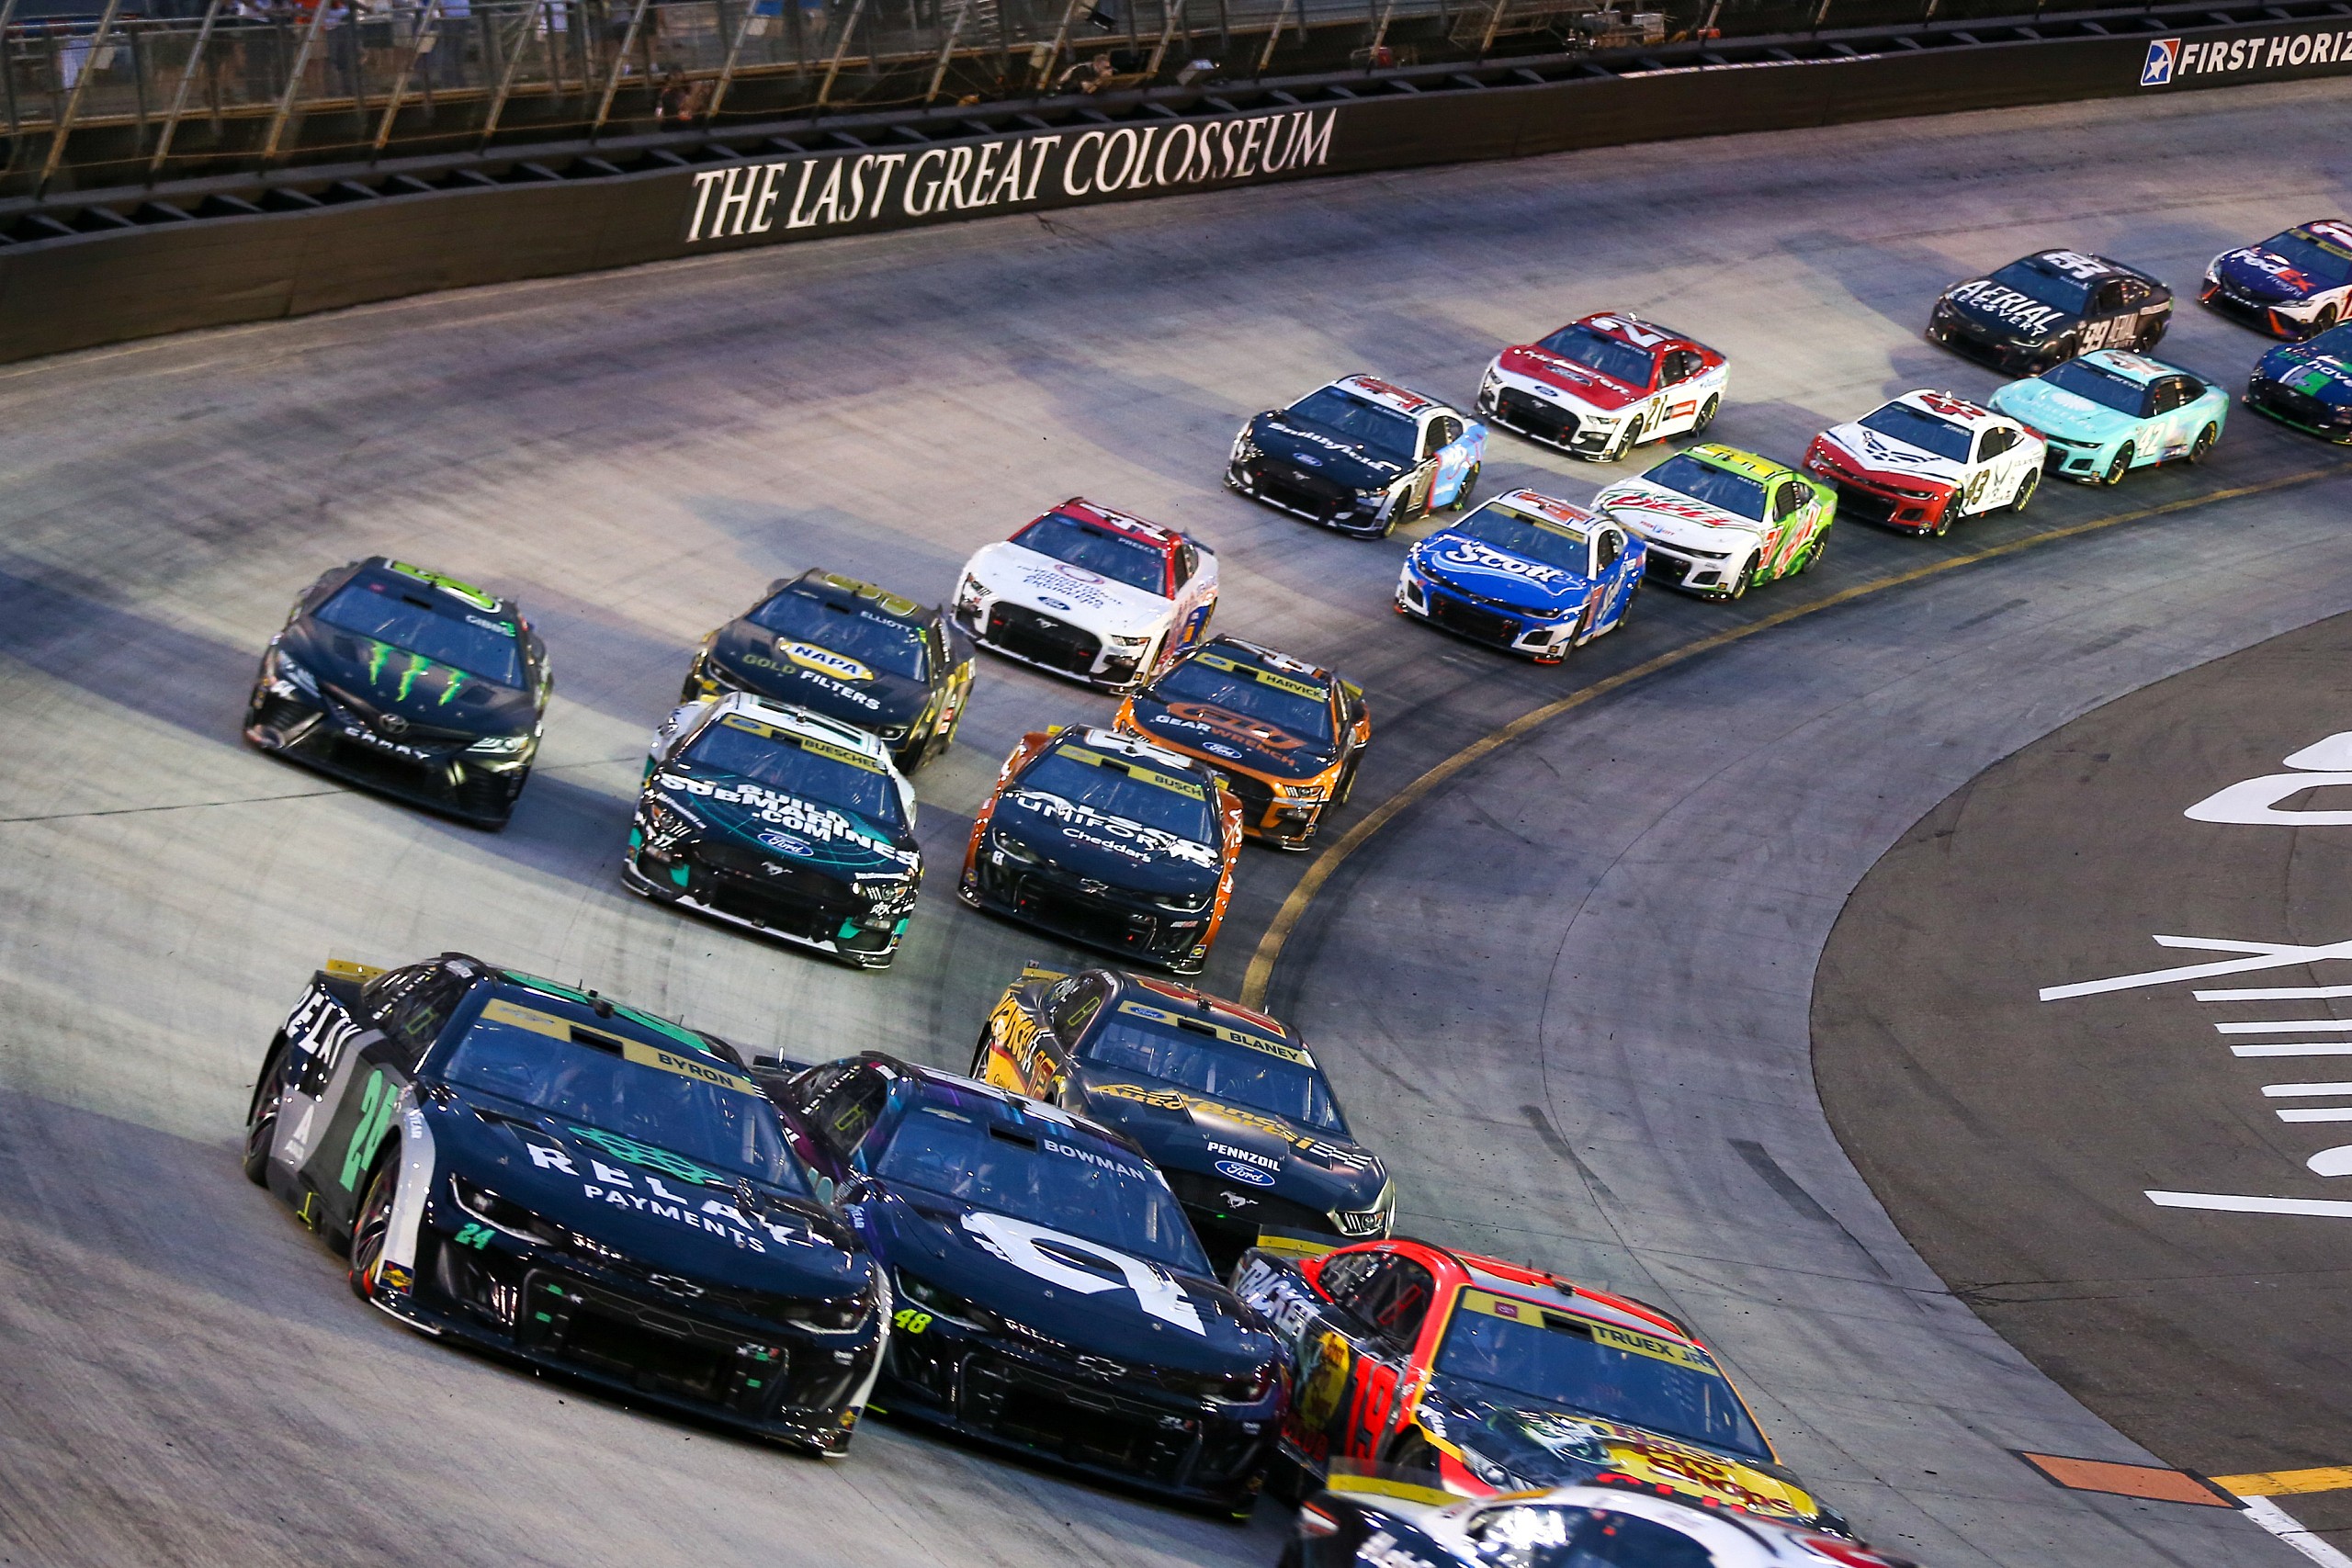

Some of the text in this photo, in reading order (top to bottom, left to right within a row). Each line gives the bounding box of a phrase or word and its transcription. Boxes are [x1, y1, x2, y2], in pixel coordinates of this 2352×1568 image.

[2177, 32, 2352, 75] FIRST HORIZ
[687, 107, 1339, 242] THE LAST GREAT COLOSSEUM
[2230, 249, 2317, 292] FedEx
[1954, 279, 2065, 333] AERIAL
[1941, 422, 1972, 437] JONES
[2137, 423, 2165, 459] 42
[1964, 469, 1991, 509] 43
[860, 610, 912, 634] ELLIOTT
[794, 645, 858, 675] NAPA
[741, 653, 881, 711] GOLD FILTERS
[1266, 674, 1323, 698] HARVICK
[1205, 742, 1240, 758] Ford
[1154, 773, 1204, 798] BUSCH
[661, 772, 919, 868] SUBMARINES
[736, 784, 851, 829] BUILD
[751, 811, 832, 842] .COM
[762, 833, 810, 855] Ford
[992, 850, 1005, 866] 8
[1062, 827, 1152, 863] Cheddar's
[1130, 1005, 1165, 1019] Ford
[1229, 1032, 1299, 1062] BLANEY
[658, 1051, 735, 1089] BYRON
[339, 1068, 398, 1192] 24
[1044, 1138, 1147, 1182] BOWMAN
[1206, 1141, 1282, 1172] PENNZOIL
[1220, 1161, 1271, 1185] Ford
[526, 1142, 797, 1247] RELAY
[584, 1183, 767, 1255] PAYMENTS
[454, 1222, 496, 1251] 24
[893, 1307, 933, 1335] 48
[1594, 1325, 1675, 1358] TRUEX
